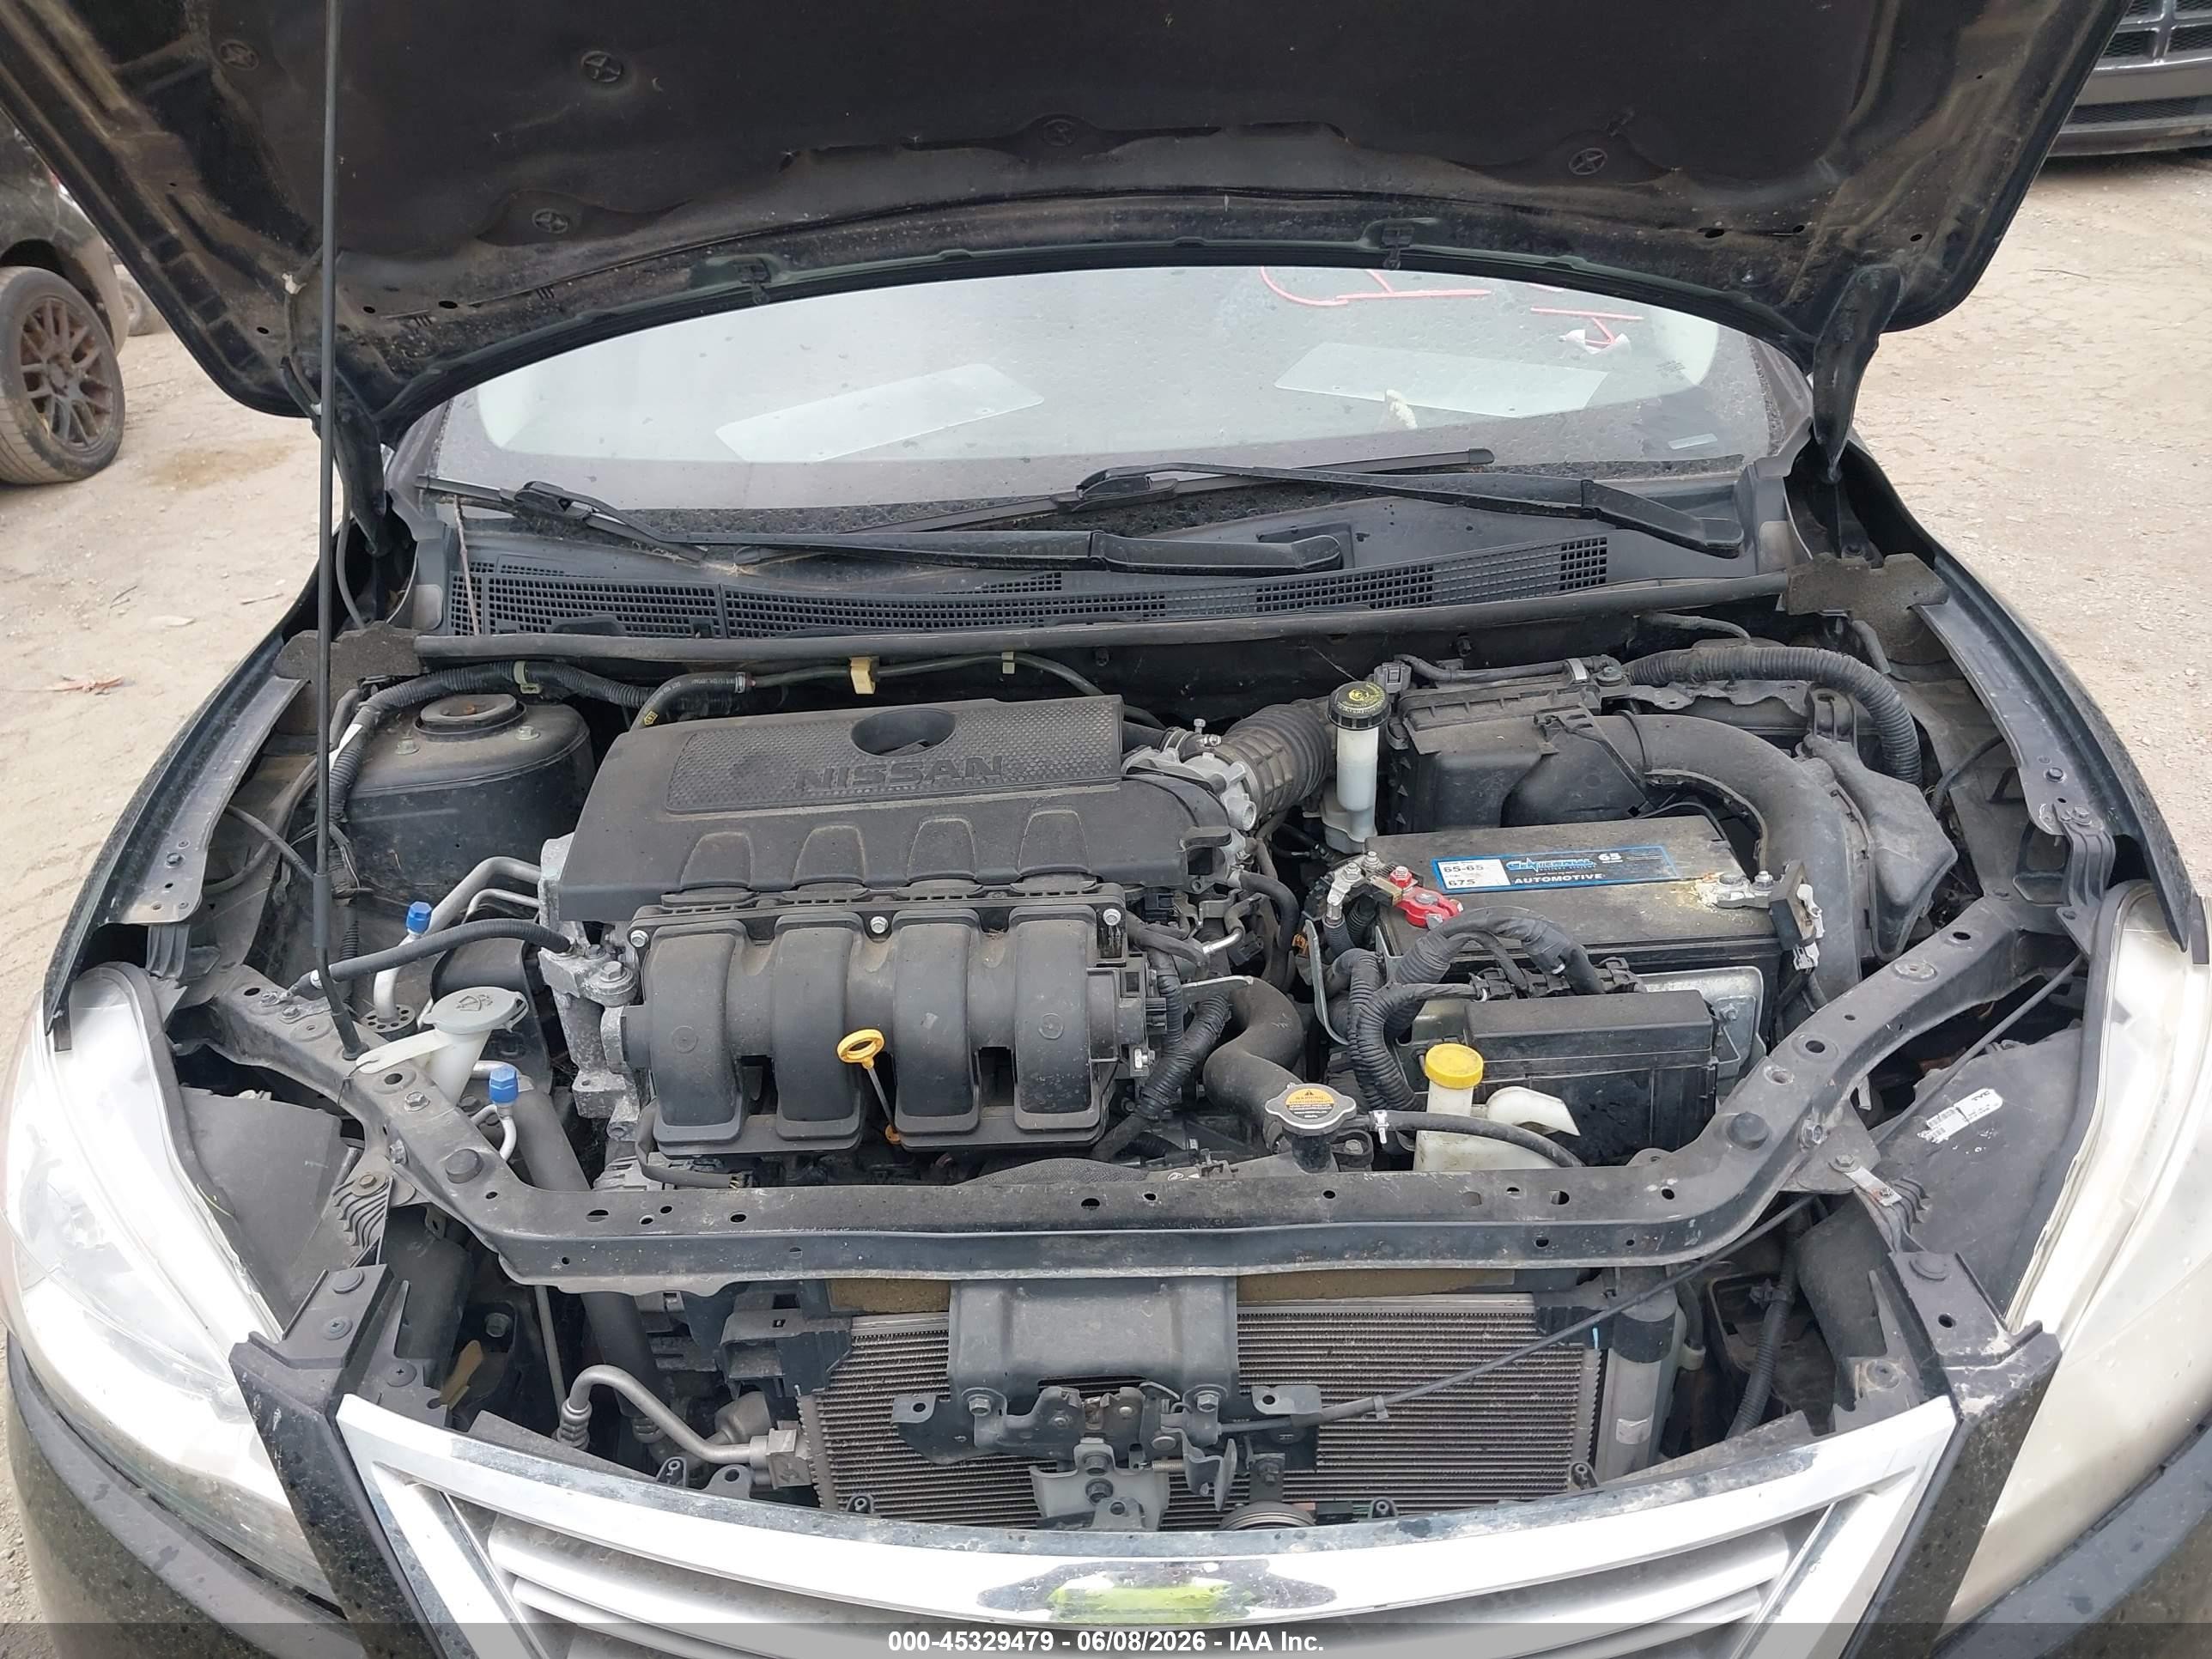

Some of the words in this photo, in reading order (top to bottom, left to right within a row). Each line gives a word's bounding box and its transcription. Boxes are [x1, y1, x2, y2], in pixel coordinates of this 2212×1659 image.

[794, 755, 1003, 791] NISSAN
[1598, 852, 1622, 861] 65
[1443, 864, 1484, 872] 65-65
[1514, 873, 1603, 884] AUTOMOTIVE
